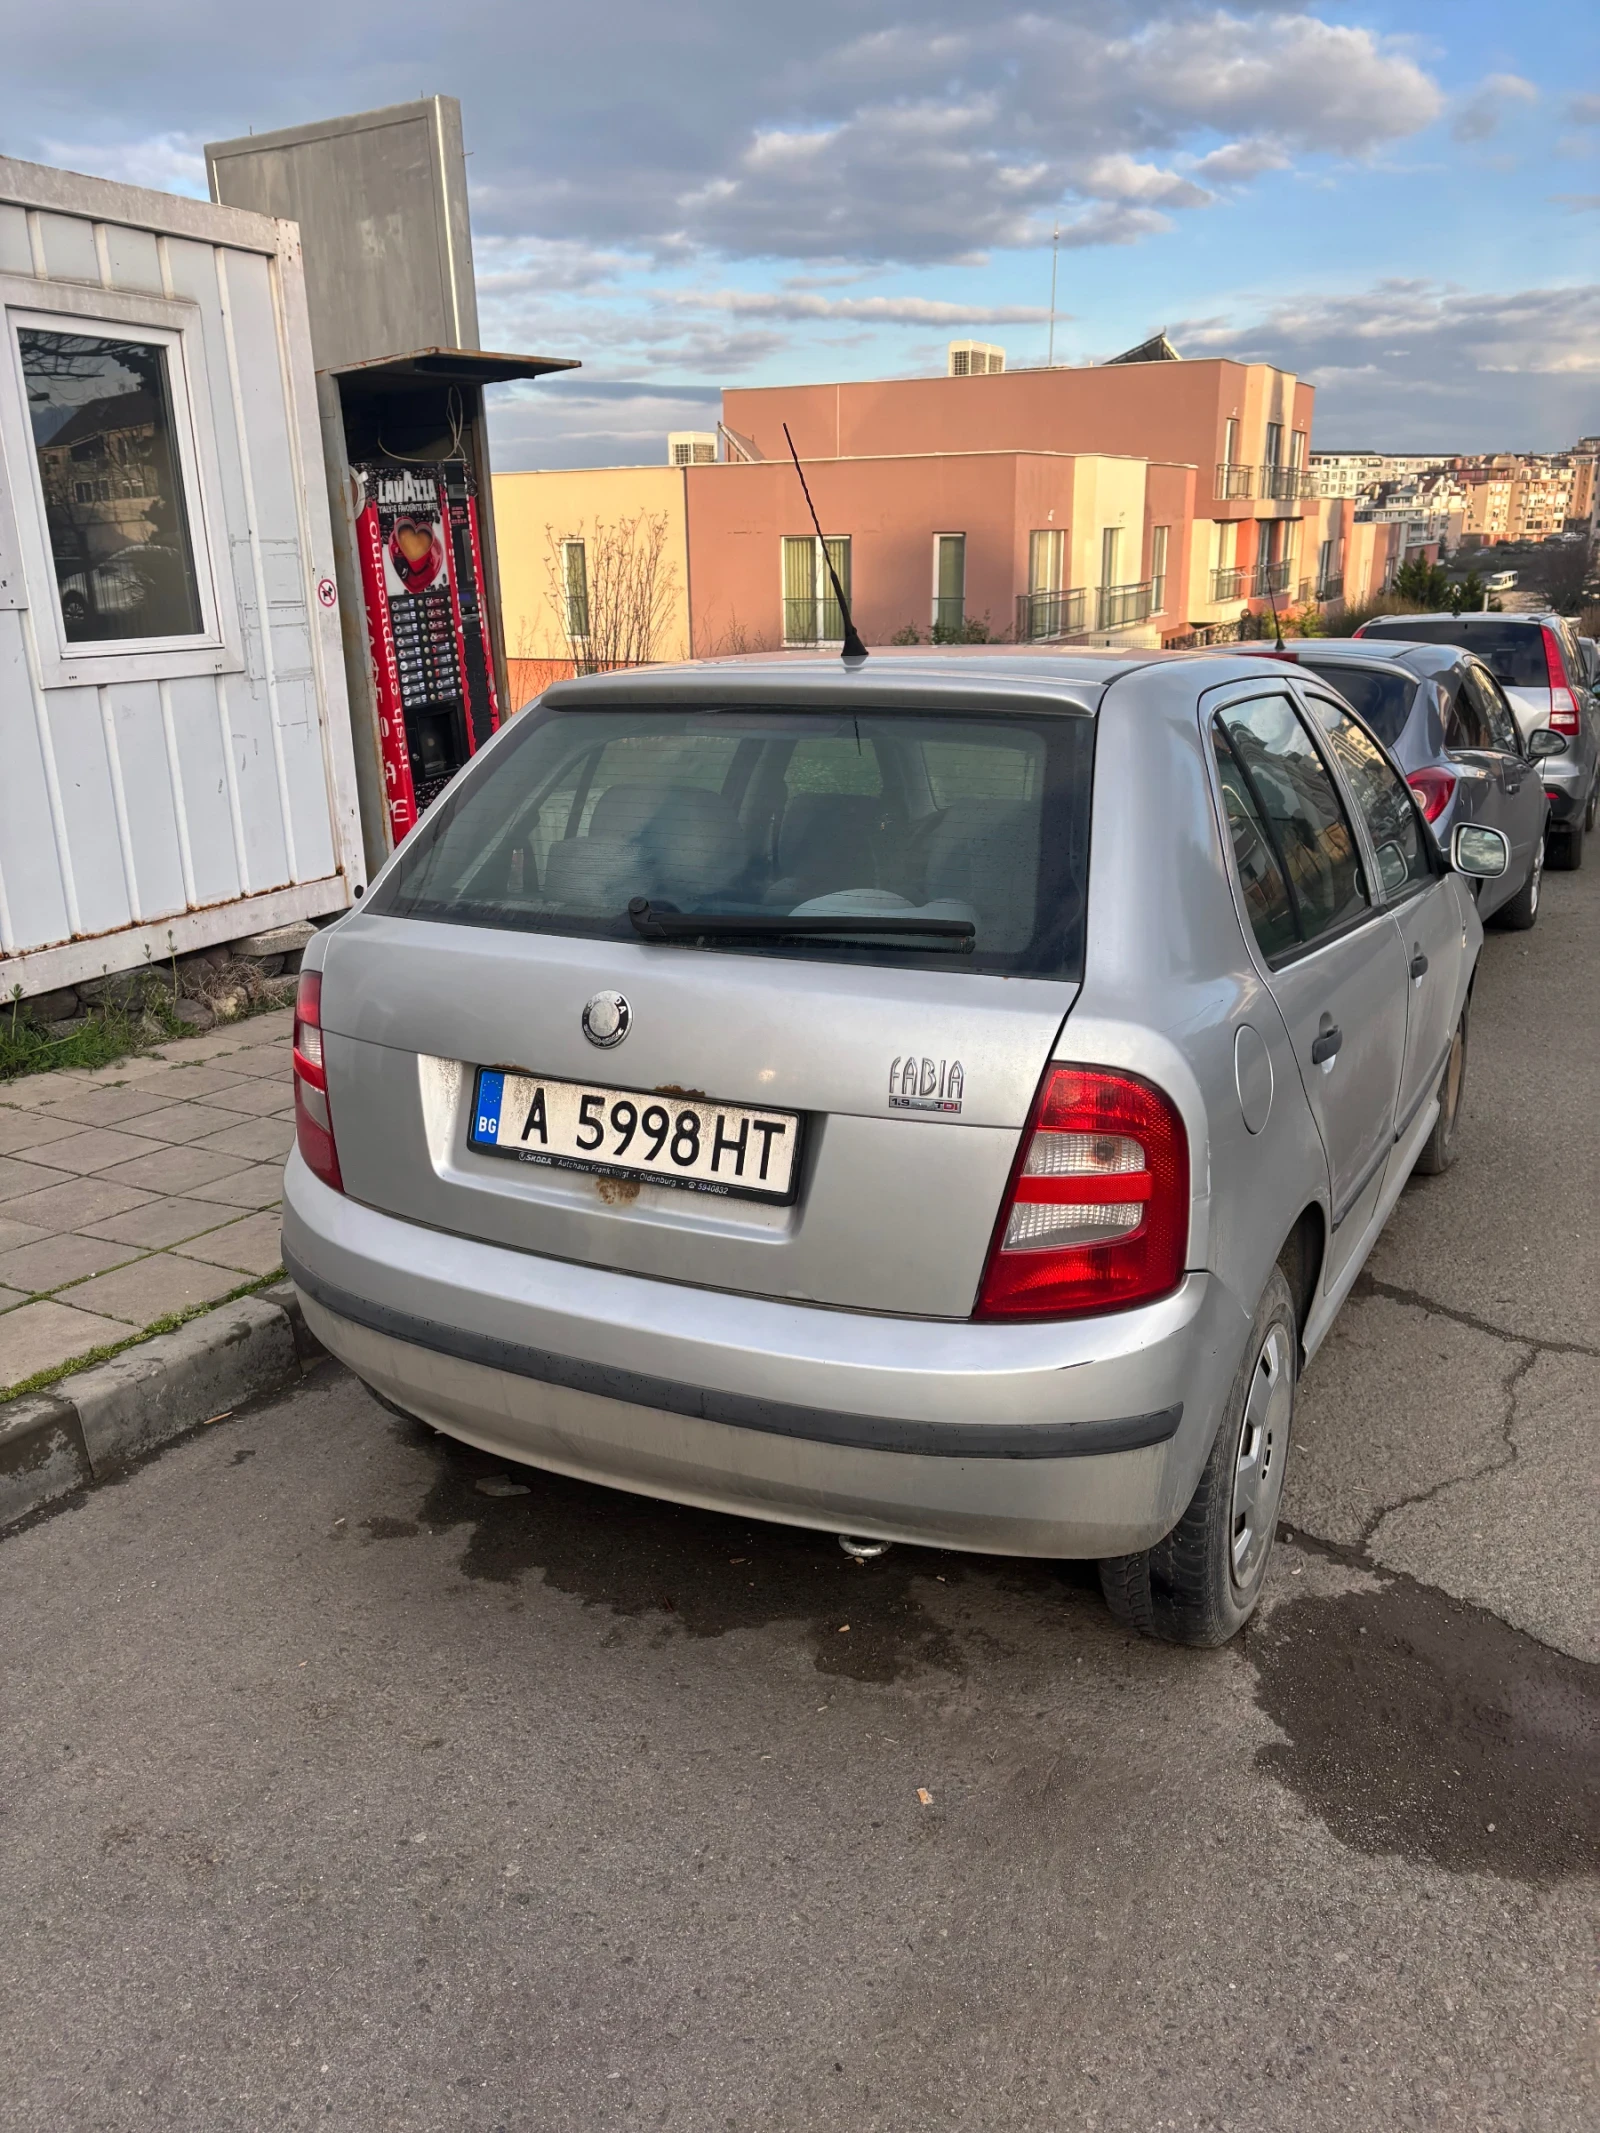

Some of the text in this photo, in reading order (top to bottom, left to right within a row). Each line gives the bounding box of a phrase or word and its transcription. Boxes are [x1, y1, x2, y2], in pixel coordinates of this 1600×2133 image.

[378, 471, 437, 503] LAVAZZA
[369, 521, 400, 696] cappuccino
[392, 707, 409, 773] irish
[889, 1056, 964, 1099] FABIA
[891, 1098, 958, 1111] 1.9 TDI
[478, 1116, 497, 1134] BG
[521, 1087, 786, 1180] A 5998 HT
[591, 1164, 610, 1175] Frank
[640, 1172, 677, 1188] Oldenburg
